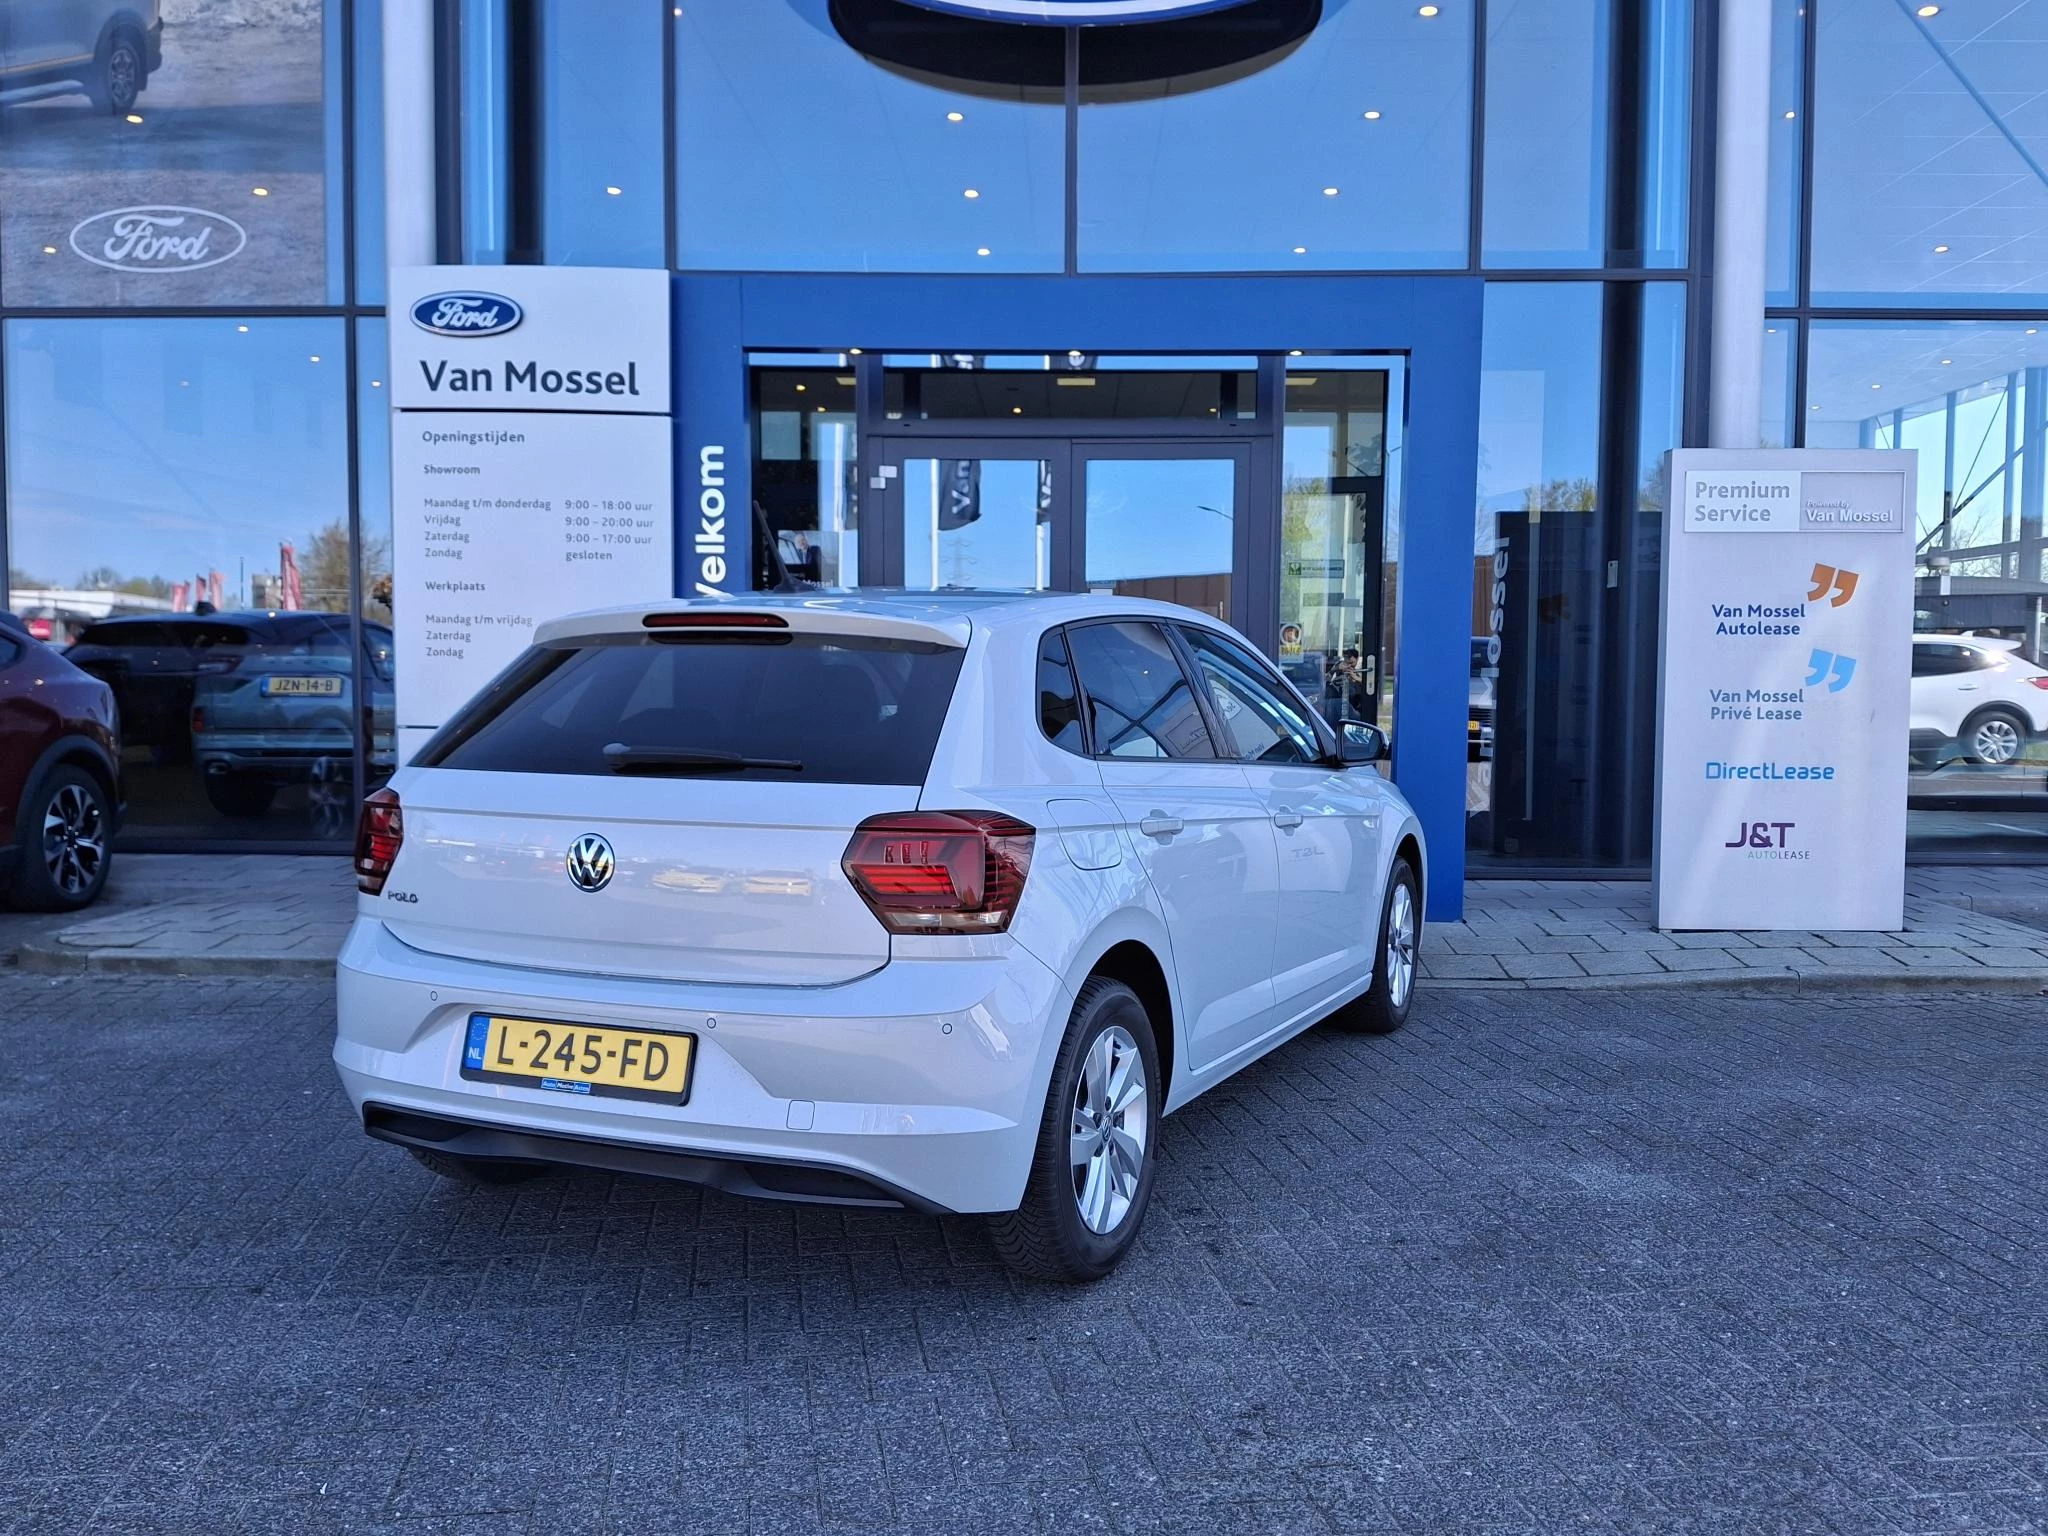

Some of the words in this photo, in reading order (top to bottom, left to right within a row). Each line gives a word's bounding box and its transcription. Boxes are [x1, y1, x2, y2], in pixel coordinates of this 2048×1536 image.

[104, 215, 212, 260] Ford
[431, 298, 499, 327] Ford
[420, 360, 493, 391] Van
[505, 361, 640, 395] Mossel
[422, 431, 525, 445] Openingstijden
[424, 465, 480, 475] Showroom
[1694, 481, 1790, 499] Premium
[424, 499, 470, 510] Maandag
[472, 499, 492, 509] t/m
[495, 499, 551, 511] donderdag
[565, 500, 589, 510] 9:00
[602, 501, 632, 511] 18:00
[635, 503, 653, 511] uur
[1694, 504, 1771, 522] Service
[1806, 508, 1835, 522] Van
[1839, 508, 1894, 522] Mossel
[424, 515, 461, 526] Vrijdag
[565, 516, 589, 527] 9:00
[602, 517, 633, 527] 20:00
[636, 520, 654, 528] uur
[424, 531, 470, 543] Zaterdag
[565, 533, 589, 543] 9:00
[602, 534, 631, 544] 17:00
[634, 536, 652, 544] uur
[424, 548, 462, 559] Zondag
[566, 551, 612, 561] gesloten
[425, 581, 486, 592] Werkplaats
[1712, 604, 1743, 618] Van
[1747, 603, 1806, 618] Mossel
[425, 614, 471, 627] Maandag
[474, 614, 494, 625] t/m
[497, 615, 533, 627] vrijdag
[1716, 622, 1801, 635] Autolease
[426, 631, 471, 642] Zaterdag
[426, 647, 464, 658] Zondag
[1709, 689, 1741, 703] Van
[1746, 689, 1804, 703] Mossel
[1710, 706, 1752, 720] Privé
[1757, 706, 1802, 720] Lease
[1706, 762, 1835, 780] DirectLease
[1725, 822, 1795, 848] J&T
[1747, 851, 1810, 860] AUTOLEASE
[388, 890, 418, 904] POLO
[468, 1047, 482, 1060] NL
[497, 1026, 669, 1082] L-245-FD
